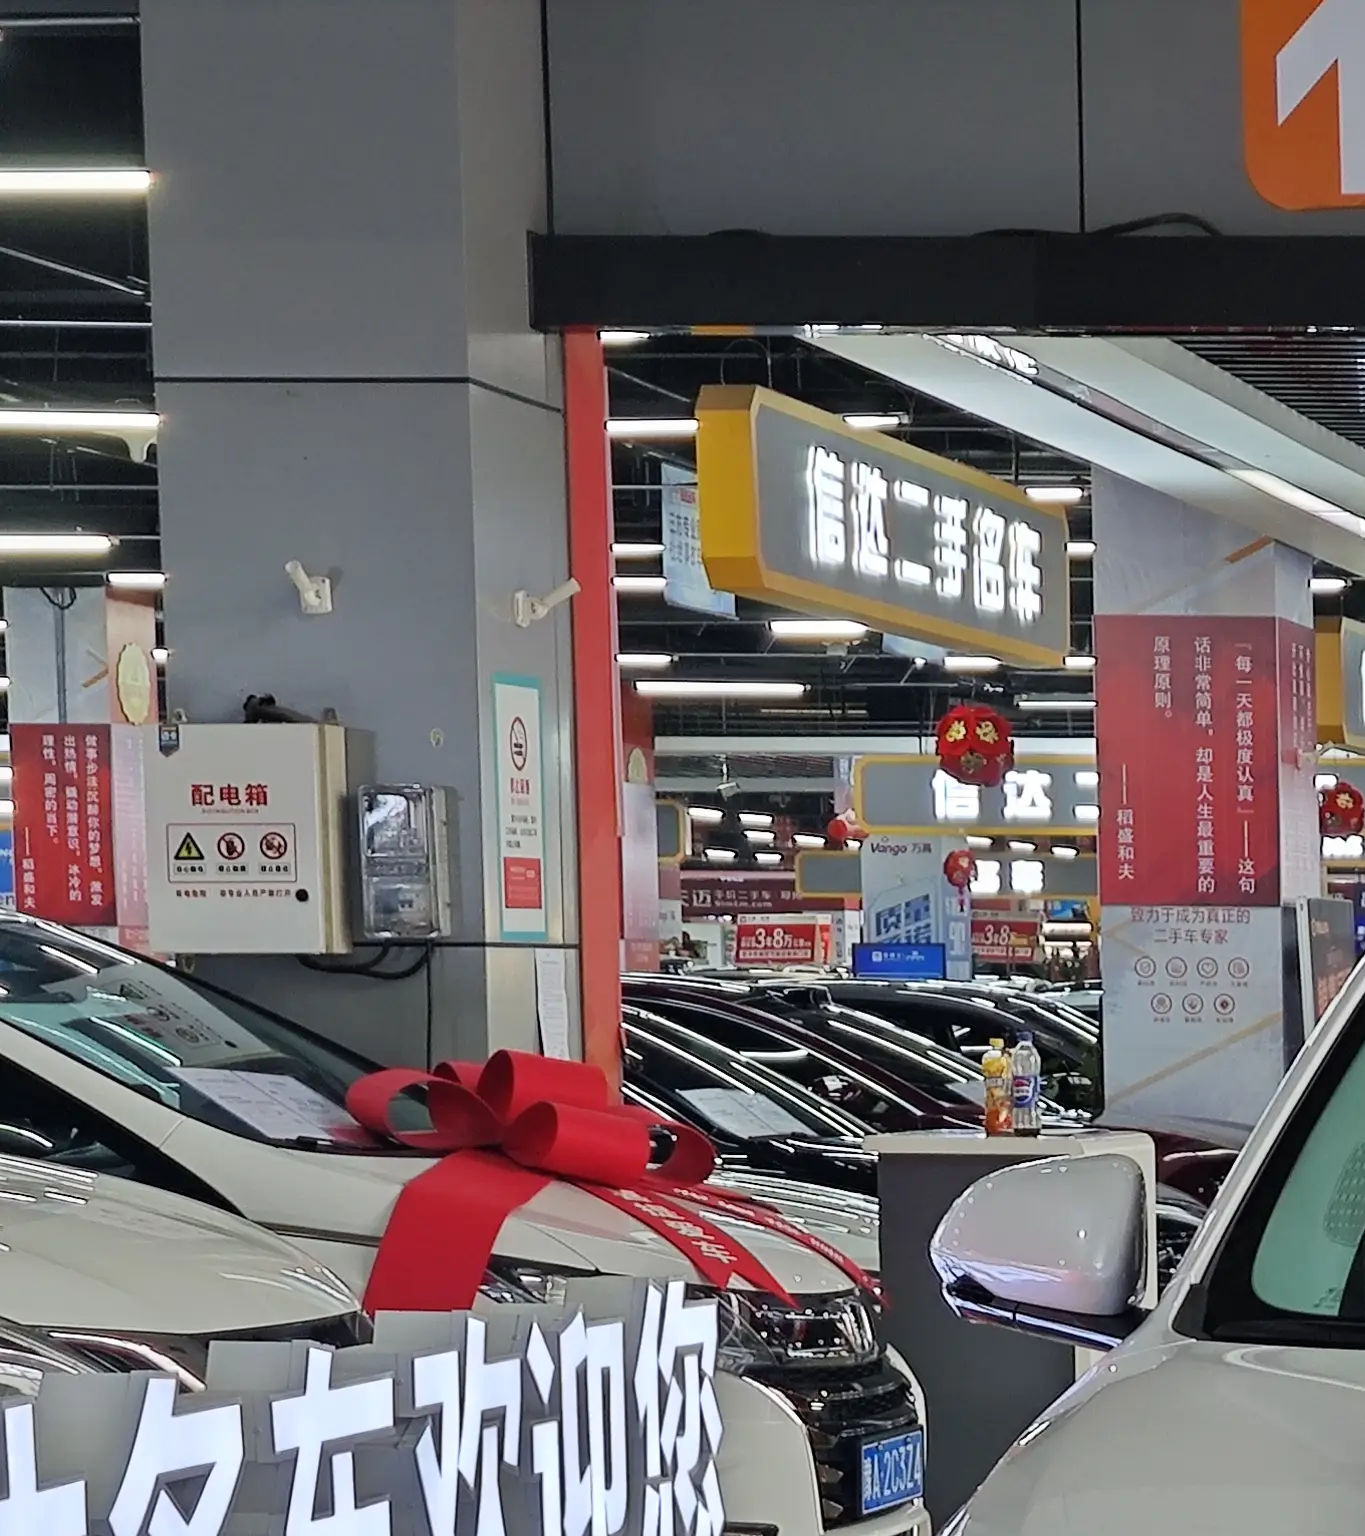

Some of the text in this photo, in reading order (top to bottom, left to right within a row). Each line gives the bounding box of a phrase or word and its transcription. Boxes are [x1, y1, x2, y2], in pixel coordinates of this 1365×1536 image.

[806, 445, 1043, 624] 信达二手名车
[191, 784, 268, 806] 配电箱
[870, 842, 907, 856] Vango
[1131, 907, 1250, 924] 致力于成为真正的
[1154, 928, 1229, 944] 二手车专家
